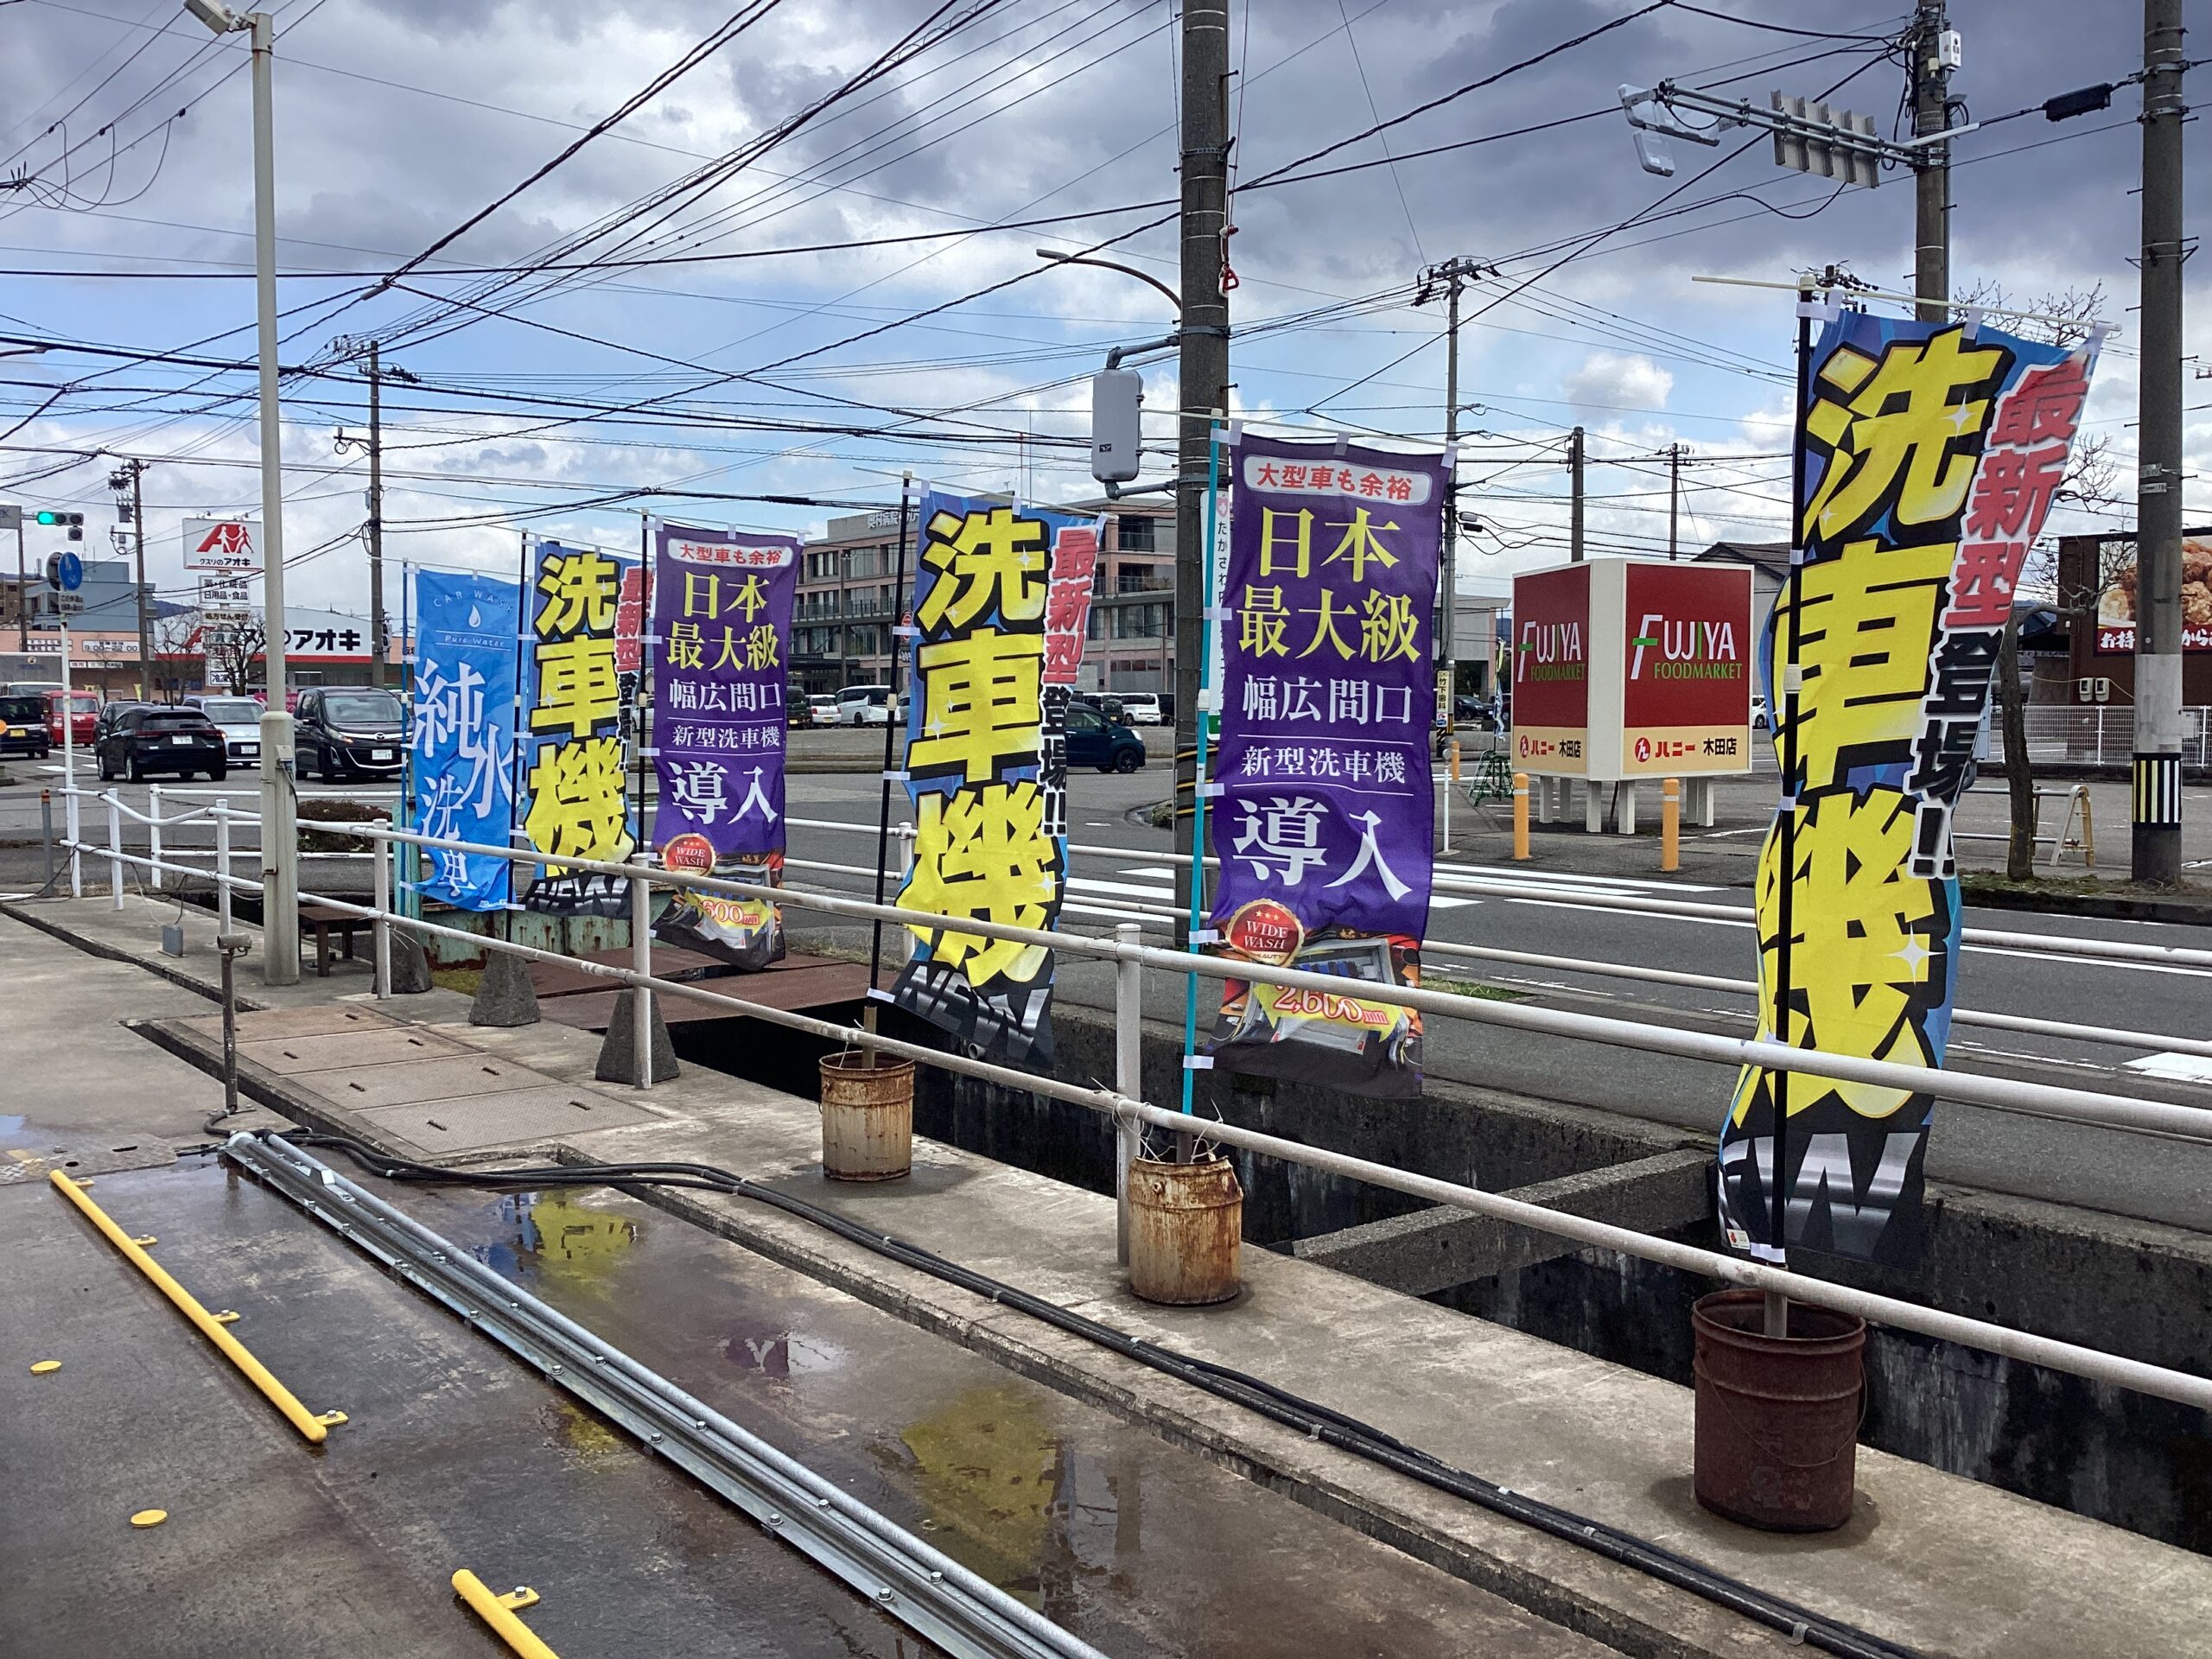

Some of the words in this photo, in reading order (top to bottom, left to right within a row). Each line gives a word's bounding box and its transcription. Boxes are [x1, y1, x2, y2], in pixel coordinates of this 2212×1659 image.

[1256, 462, 1413, 502] 大型車も余裕
[200, 557, 251, 567] クスリのアオキ
[679, 543, 784, 566] 大型車も余裕
[1260, 505, 1400, 582] 日本
[433, 591, 463, 607] CAR
[474, 589, 513, 613] WASH
[684, 571, 771, 624] 日本
[474, 637, 505, 647] Water
[1237, 583, 1422, 664] 最大級
[666, 620, 779, 671] 最大級
[1517, 620, 1581, 683] FUJIYA
[1630, 614, 1736, 680] FUJIYA
[1654, 662, 1743, 680] FOODMARKET
[526, 553, 635, 877] 洗車機
[670, 678, 780, 713] 幅広間口
[1242, 674, 1413, 725] 幅広間口
[412, 658, 522, 818] 純水
[673, 723, 780, 749] 新型洗車機
[897, 507, 1055, 988] 洗車機
[1655, 741, 1695, 759] ハニー
[1703, 737, 1737, 757] 木田店
[1732, 328, 2002, 1128] 洗車機
[1241, 746, 1406, 785] 新型洗車機
[1530, 740, 1555, 756] ハニー
[1559, 739, 1581, 759] 木田店
[668, 761, 779, 825] 導入
[674, 855, 704, 867] WASH
[676, 846, 706, 858] WIDE
[1232, 797, 1413, 902] 導入
[1244, 935, 1286, 950] WASH
[1246, 920, 1288, 938] WIDE
[899, 965, 1050, 1061] NEW
